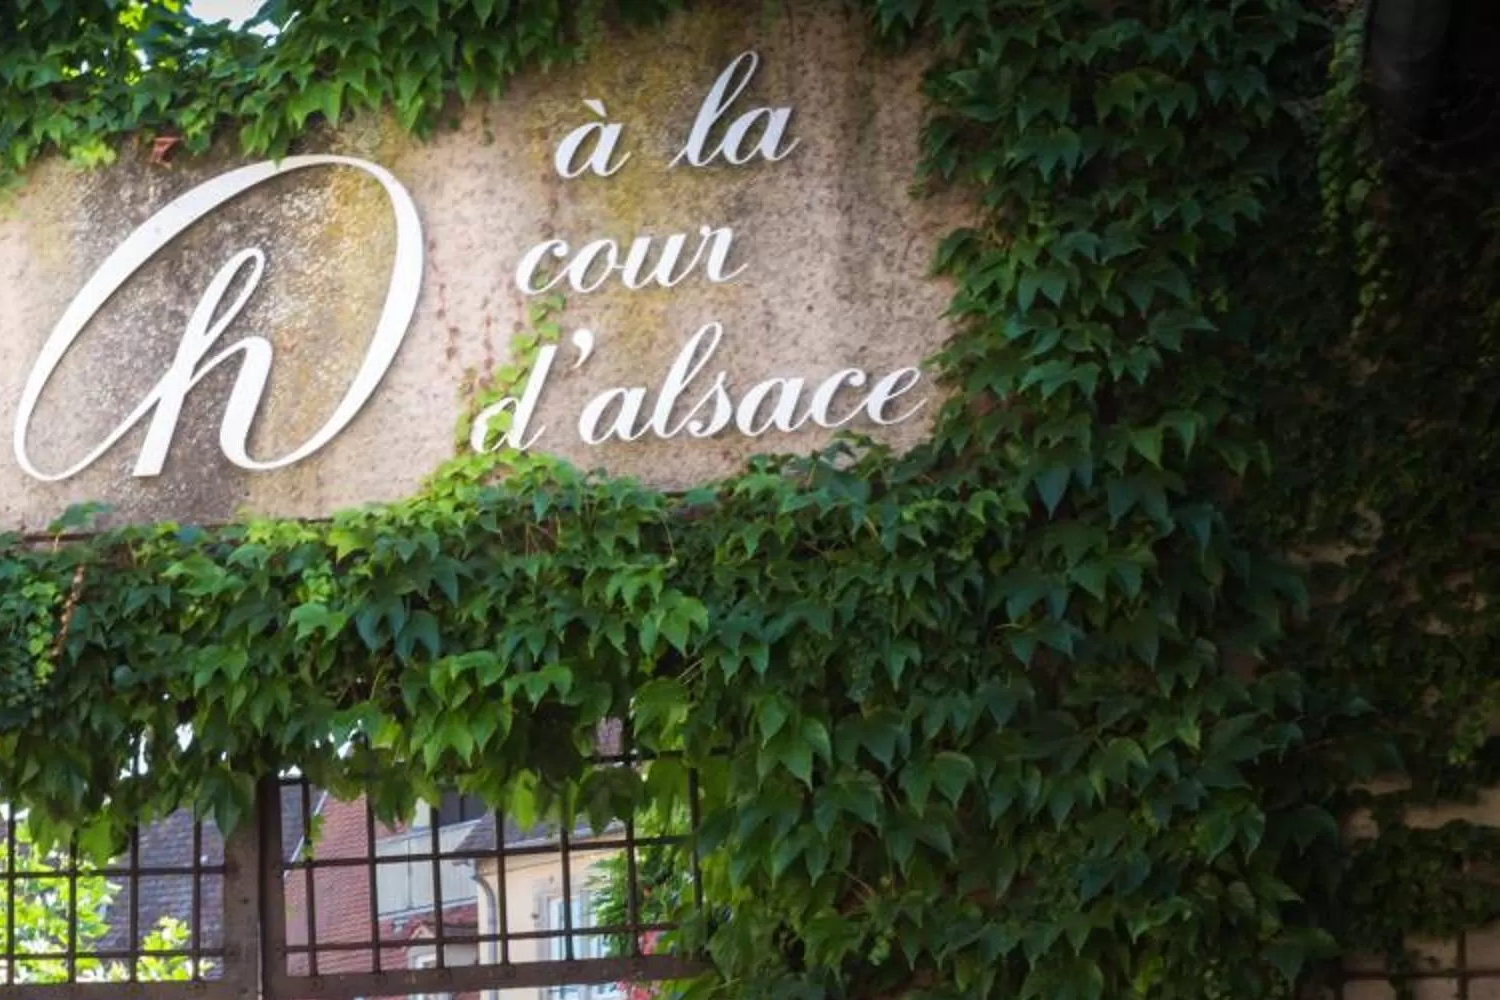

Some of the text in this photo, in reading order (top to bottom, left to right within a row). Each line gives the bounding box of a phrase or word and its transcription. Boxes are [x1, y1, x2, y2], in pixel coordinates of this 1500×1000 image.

[554, 51, 801, 180] à la
[514, 223, 749, 295] cour
[471, 322, 929, 455] d'alsace
